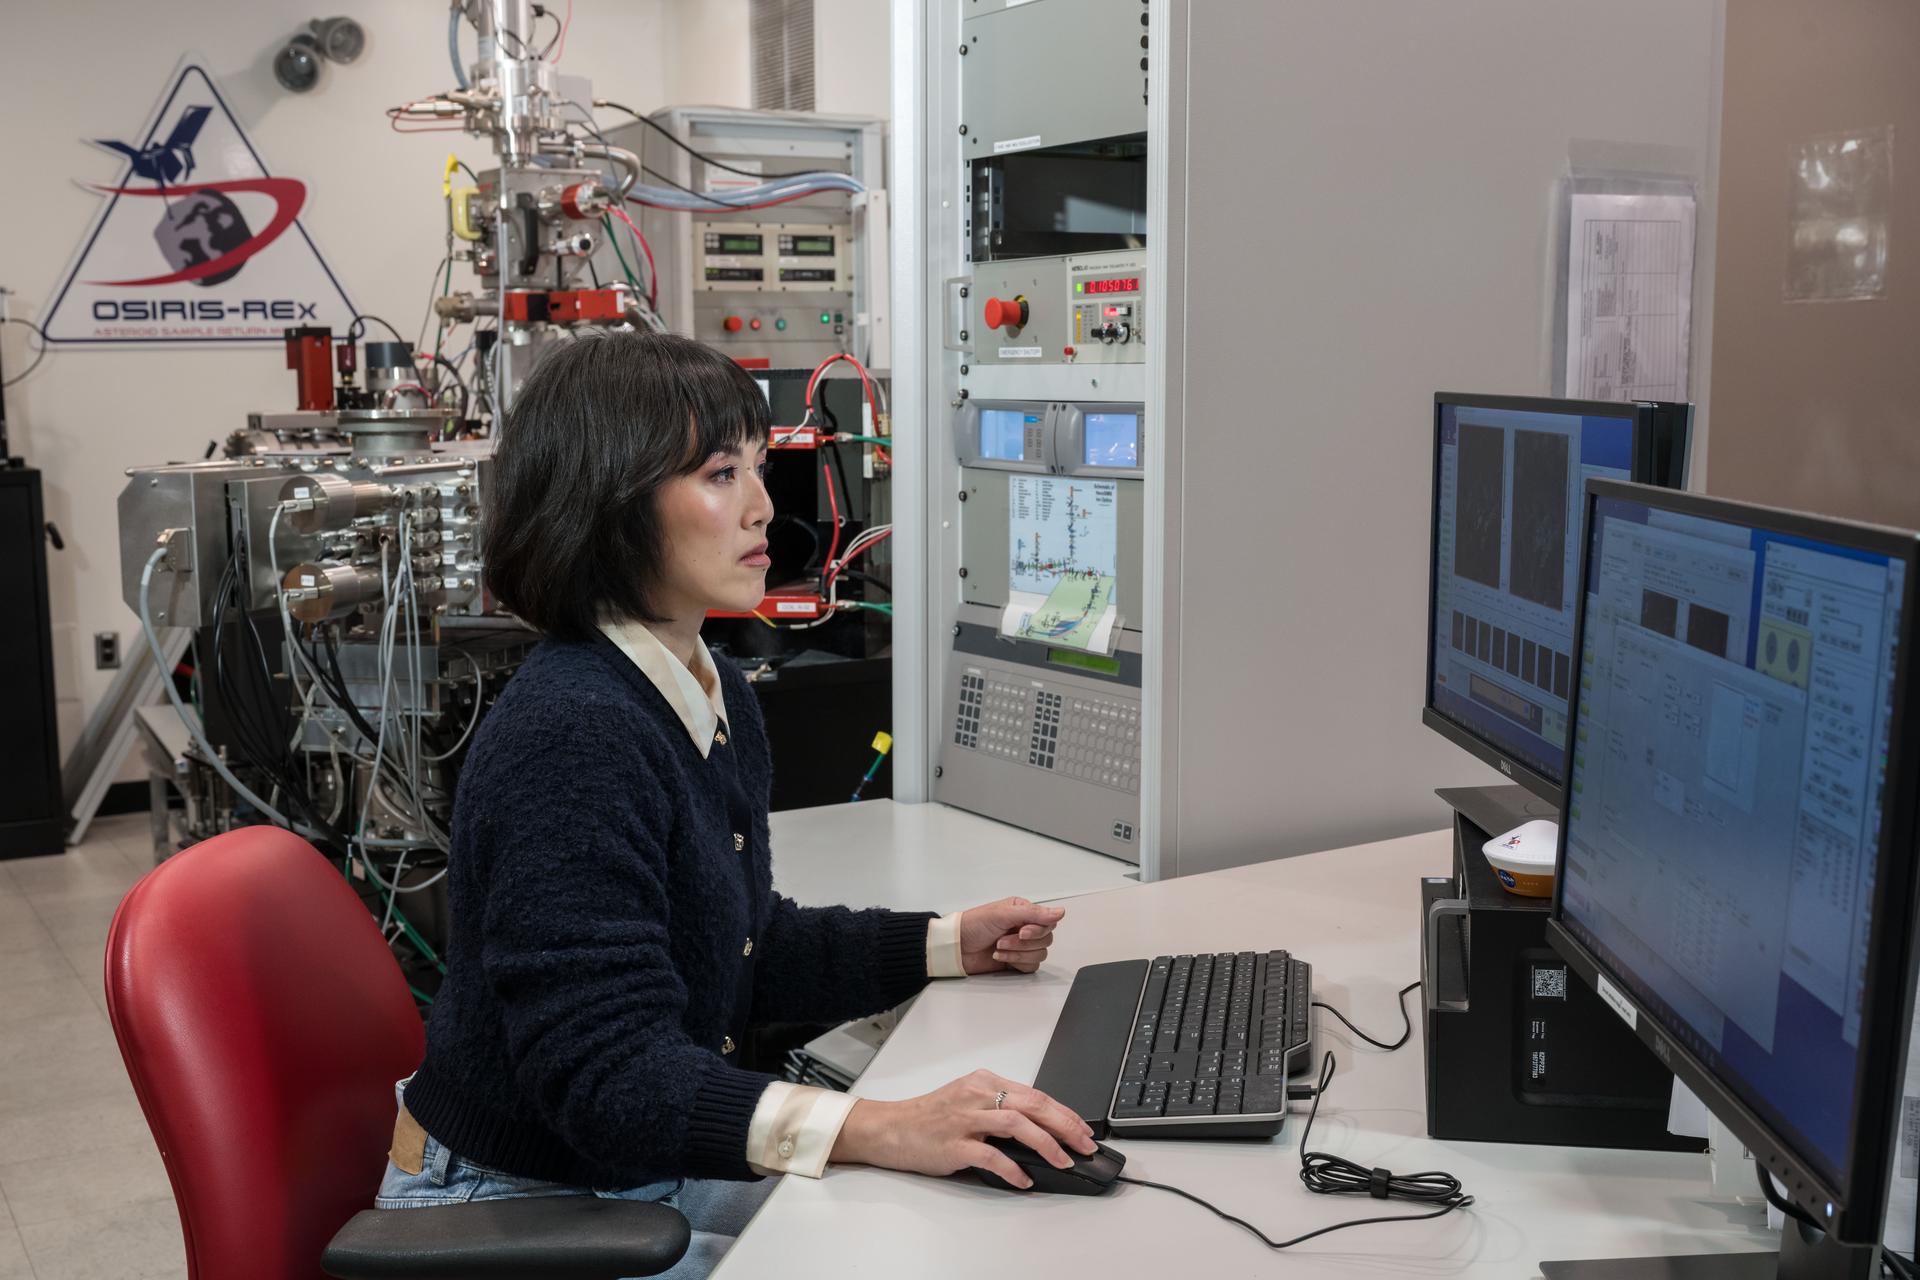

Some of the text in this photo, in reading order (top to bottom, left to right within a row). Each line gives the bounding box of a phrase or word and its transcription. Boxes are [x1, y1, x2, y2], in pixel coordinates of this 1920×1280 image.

[94, 327, 158, 337] ASTEROID
[161, 327, 214, 336] SAMPLE
[217, 326, 267, 336] RETURN
